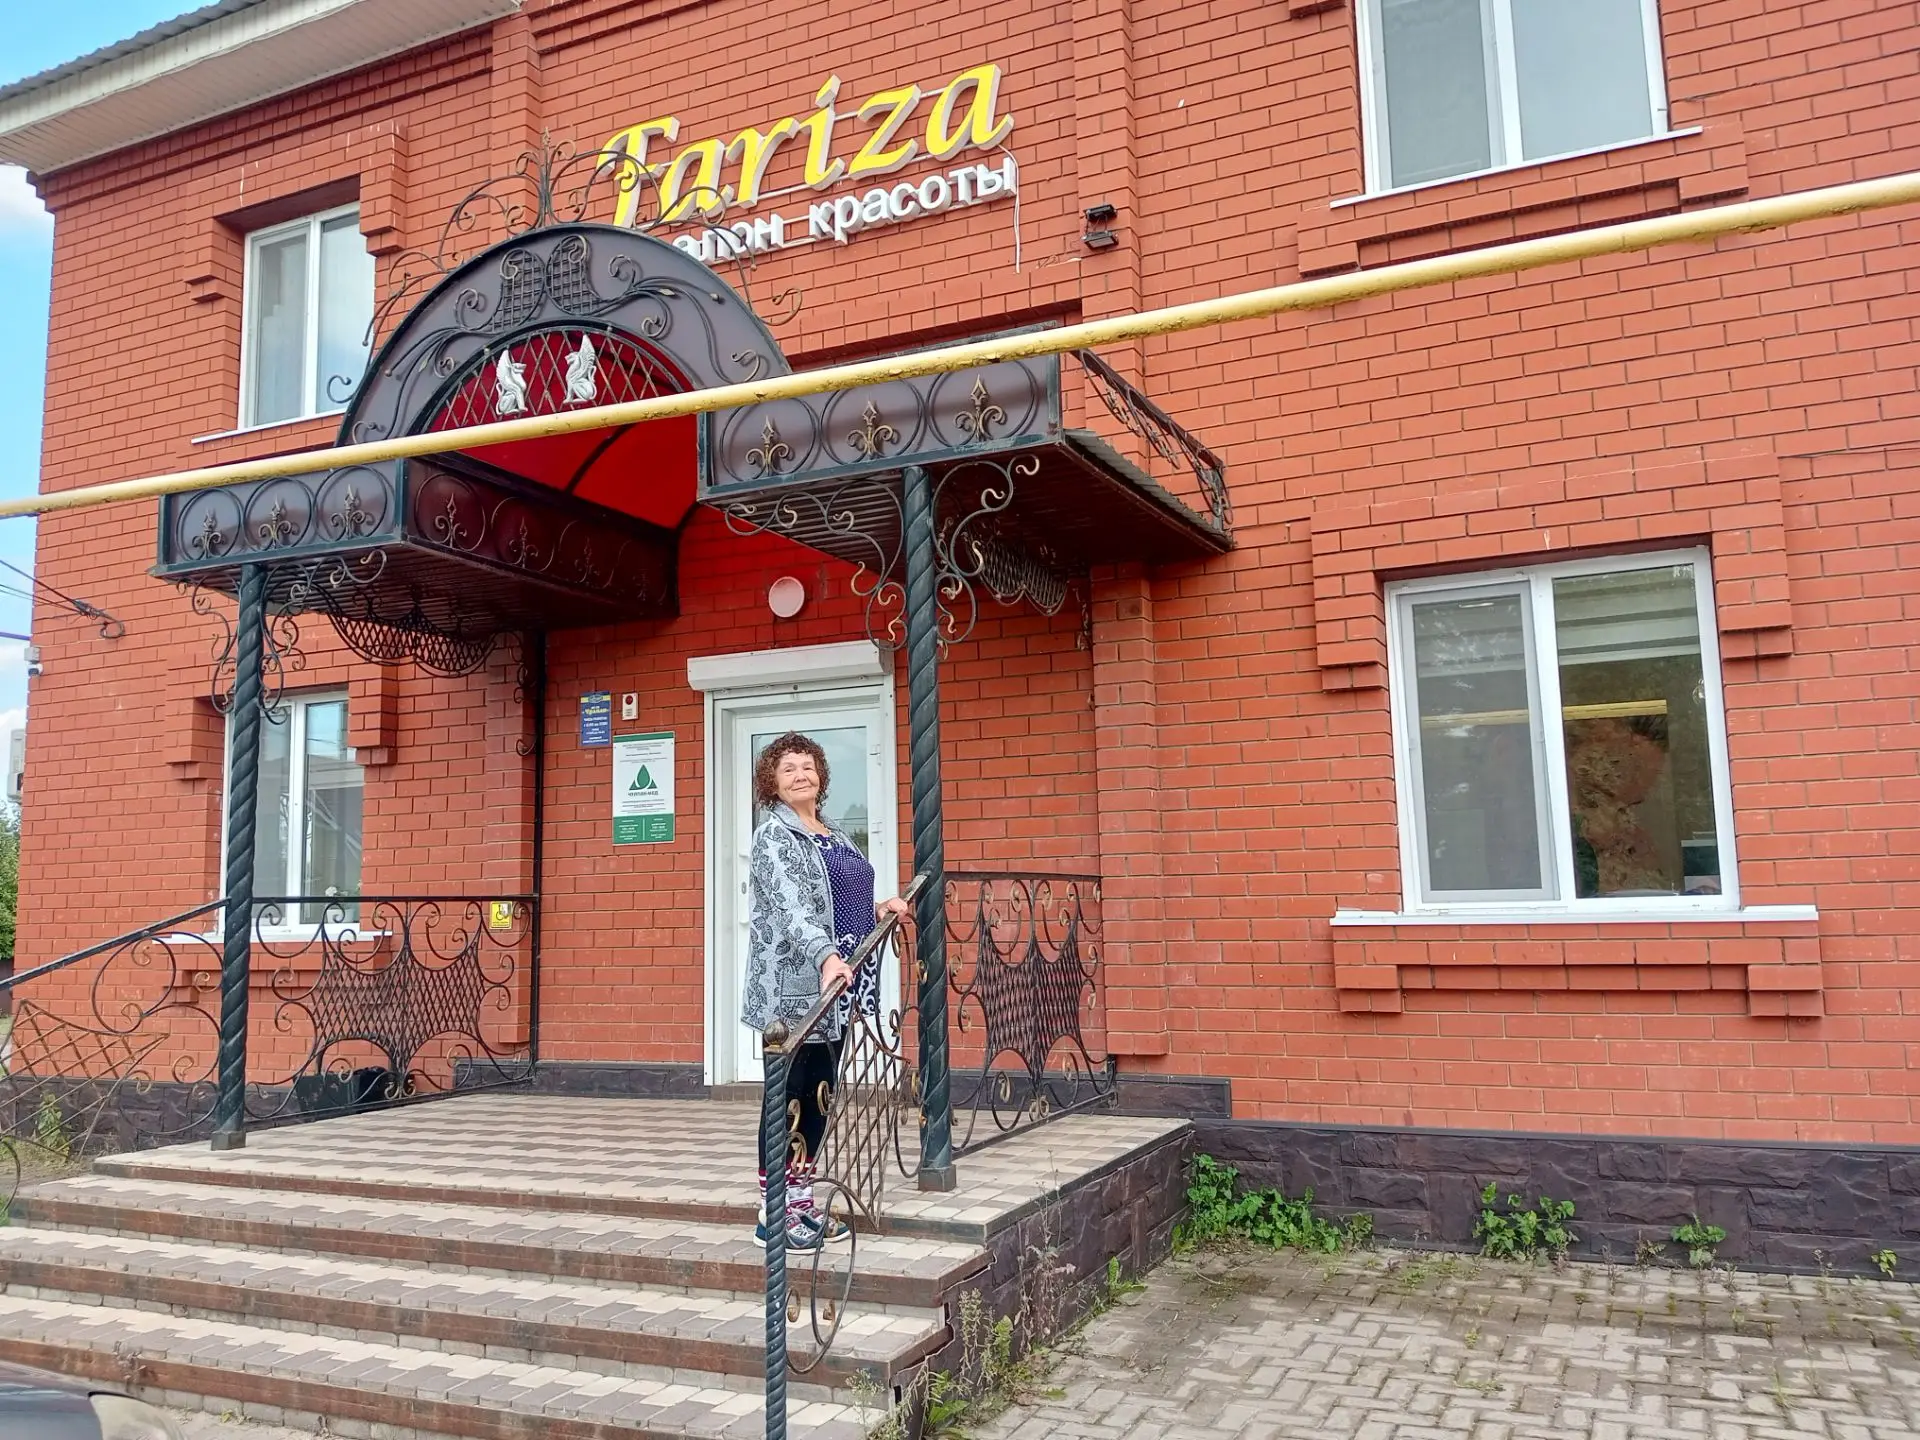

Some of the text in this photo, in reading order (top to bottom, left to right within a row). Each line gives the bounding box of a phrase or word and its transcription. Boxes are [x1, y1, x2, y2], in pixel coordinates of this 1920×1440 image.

[597, 62, 1014, 227] Fariza
[672, 157, 1017, 262] алон красоты
